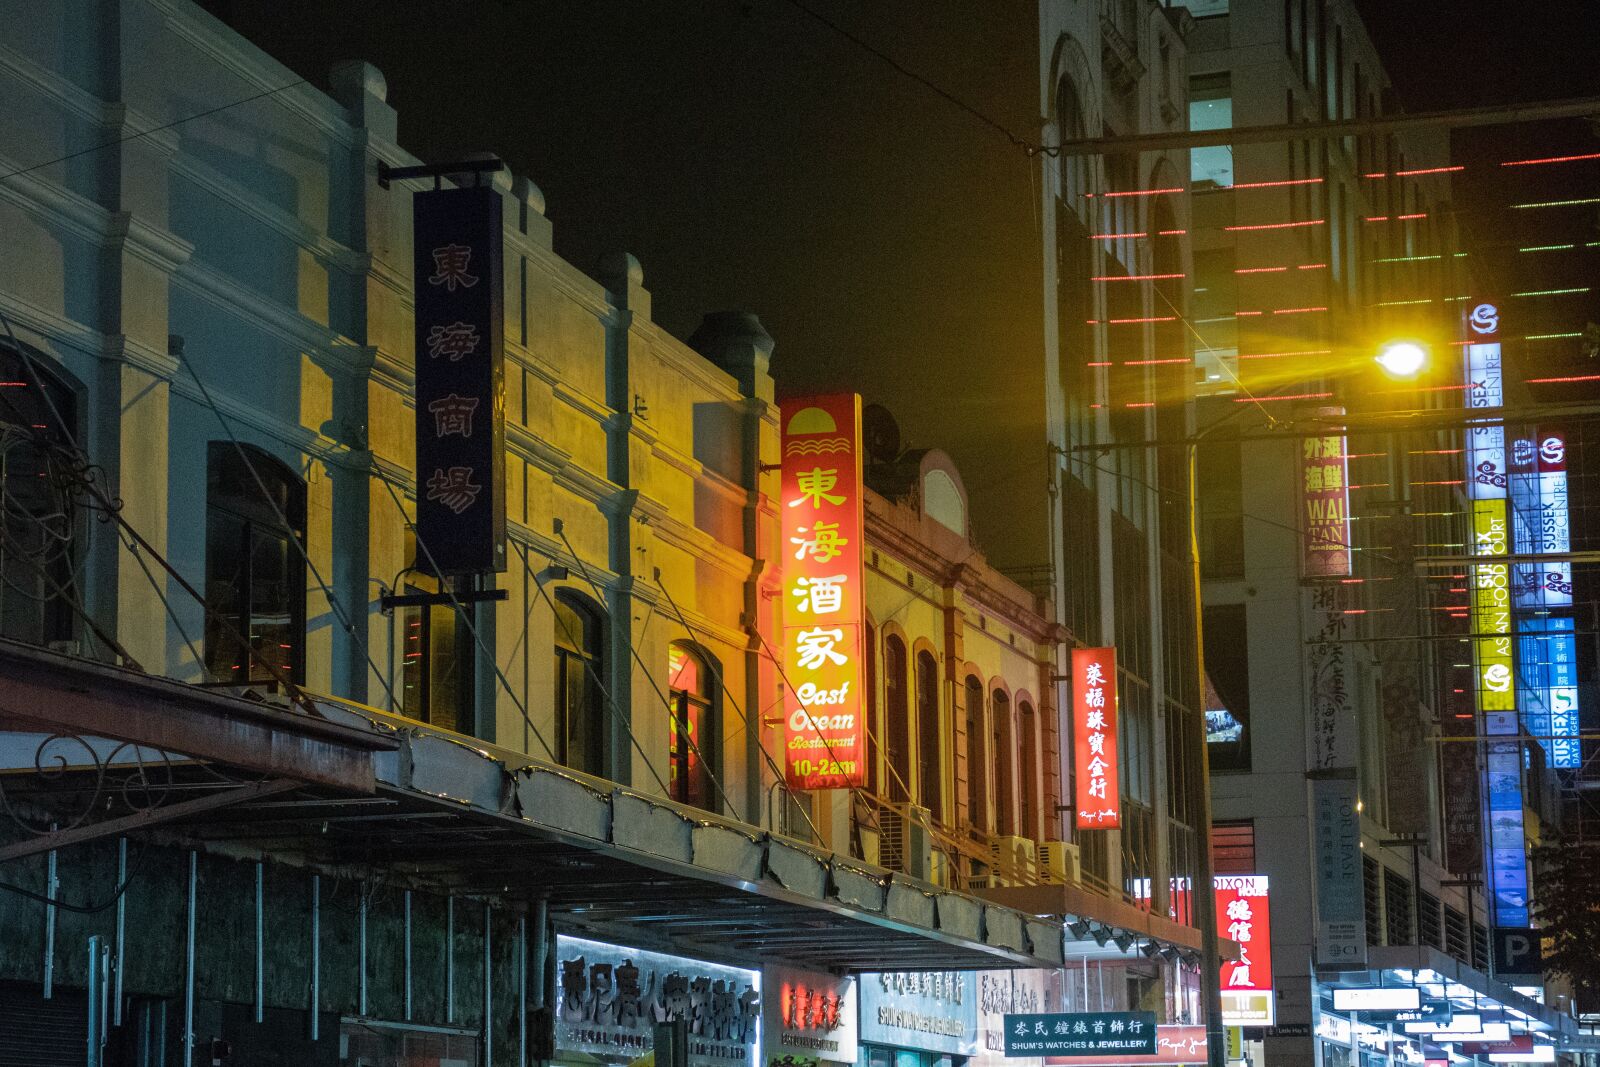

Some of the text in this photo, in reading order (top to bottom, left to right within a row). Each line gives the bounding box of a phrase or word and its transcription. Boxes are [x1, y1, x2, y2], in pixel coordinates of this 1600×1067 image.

[427, 243, 481, 514] 東海商場
[1472, 380, 1488, 435] SSEX
[1307, 497, 1344, 526] WAI
[1554, 480, 1568, 528] CENTRE
[1308, 525, 1343, 543] TAN
[1542, 502, 1556, 549] SUSSEX
[788, 466, 849, 670] 東海酒家
[1491, 517, 1510, 656] ASAN FOOD OURT
[797, 681, 850, 706] East
[789, 708, 855, 731] Ocean
[787, 734, 857, 750] Restaurant
[1554, 711, 1571, 766] SUSSEX
[793, 758, 856, 777] 10-2am
[1571, 747, 1580, 764] DAY
[1504, 934, 1530, 967] P
[1015, 1020, 1144, 1036] 岑氏鐘錶首飾行
[1011, 1040, 1148, 1050] SHUM'S WATCHES & JEWELLERY
[1158, 1037, 1186, 1056] Royal
